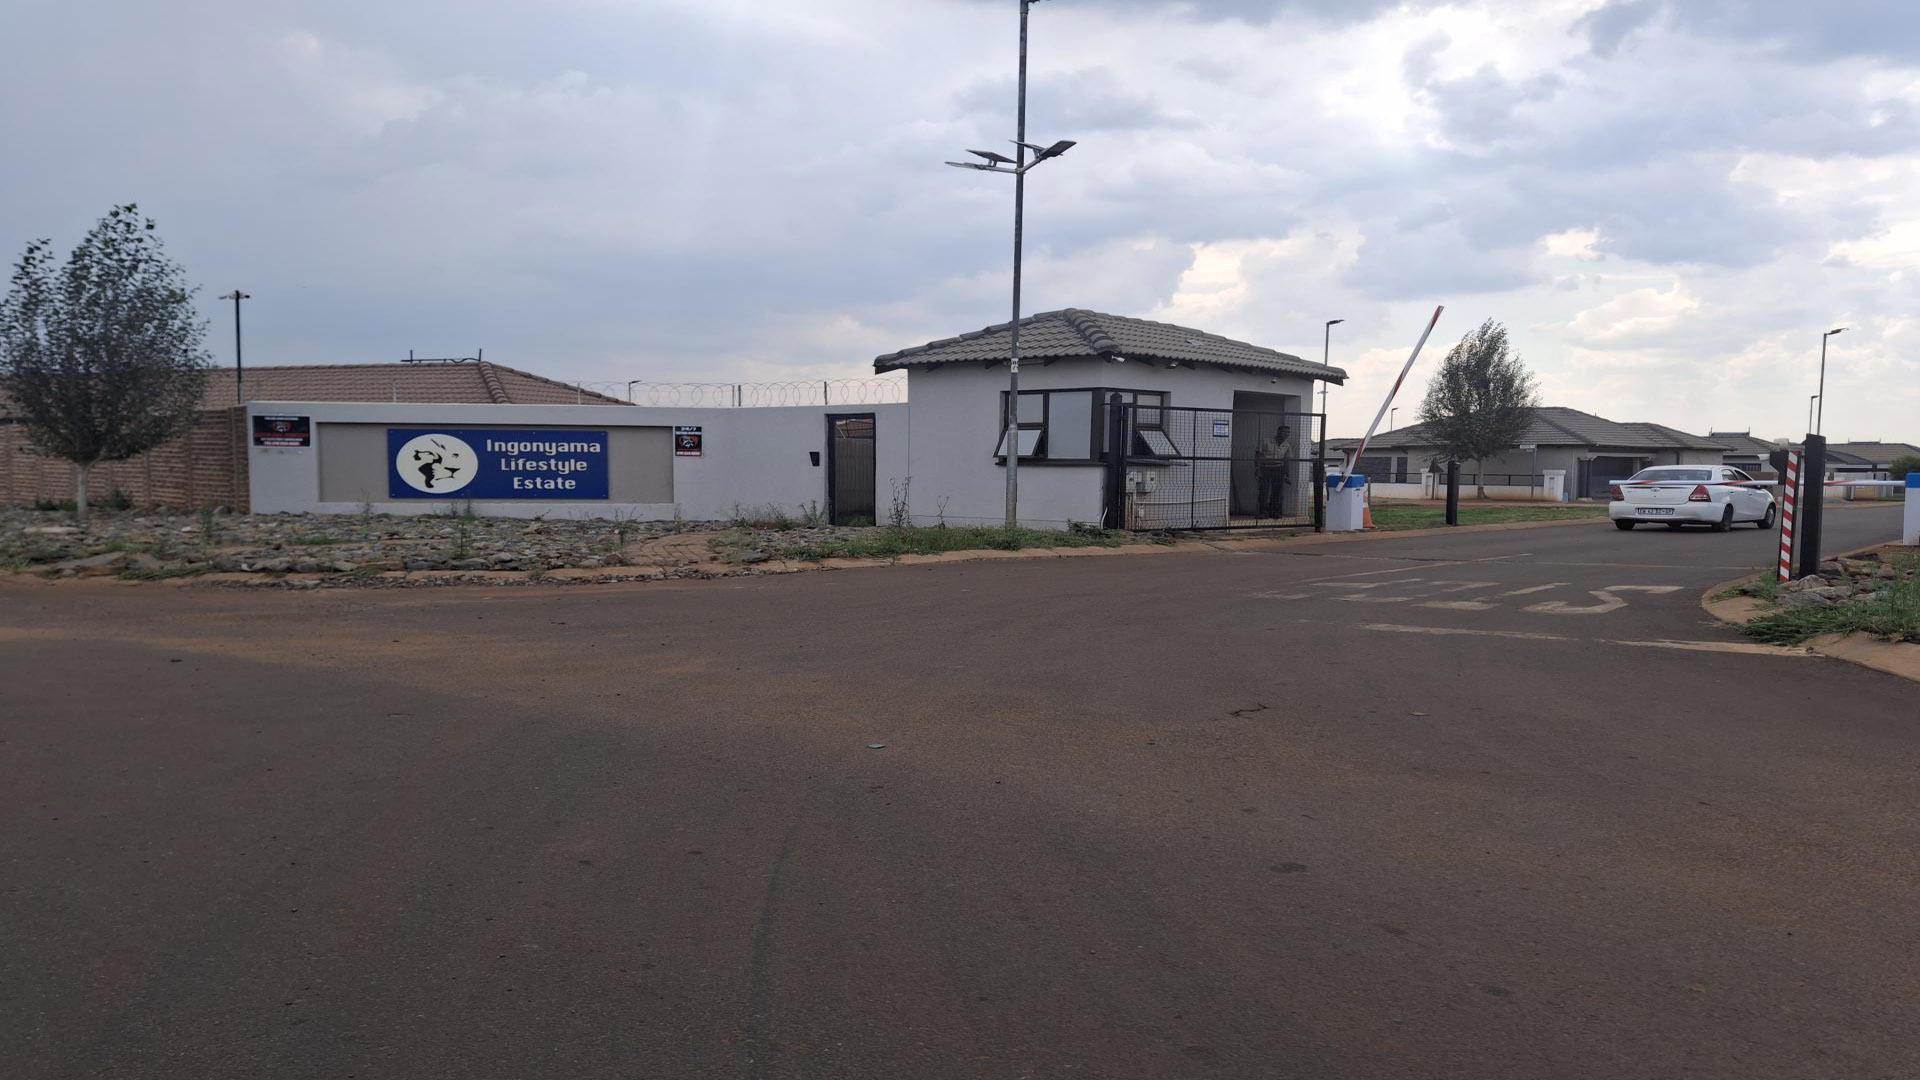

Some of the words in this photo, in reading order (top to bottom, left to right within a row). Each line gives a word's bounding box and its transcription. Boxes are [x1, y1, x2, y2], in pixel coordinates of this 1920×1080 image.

[486, 439, 601, 456] Ingonyama
[500, 458, 588, 475] Lifestyle
[513, 476, 577, 490] Estate
